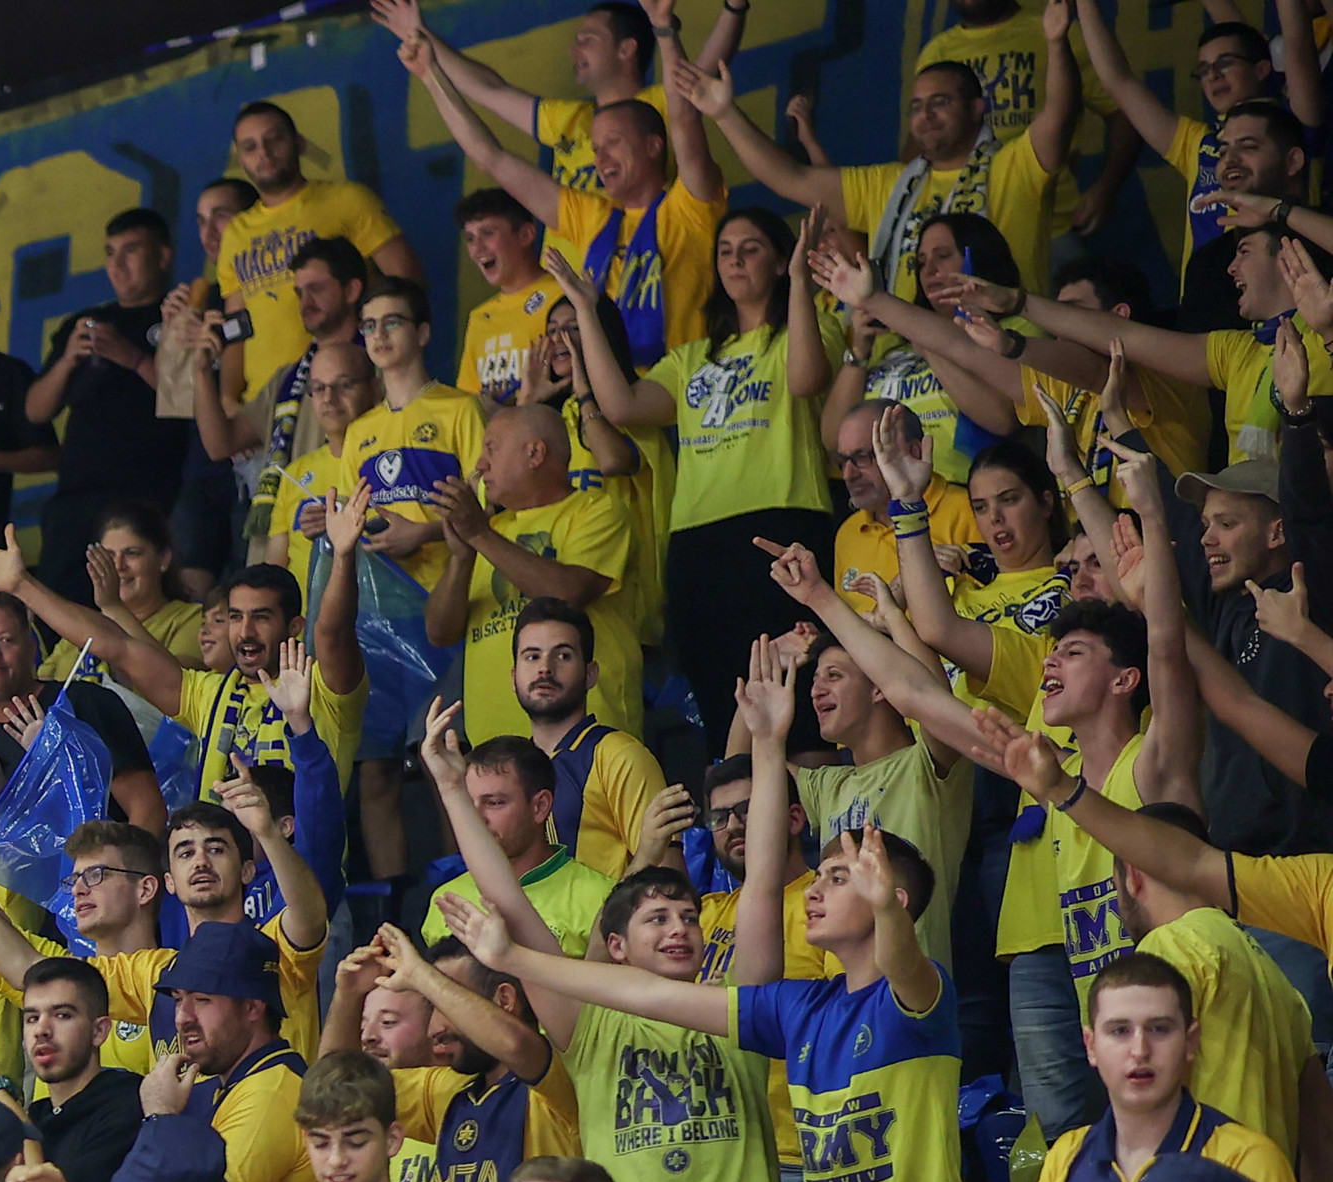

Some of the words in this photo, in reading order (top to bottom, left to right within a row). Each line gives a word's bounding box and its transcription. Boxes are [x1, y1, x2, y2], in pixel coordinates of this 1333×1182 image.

[615, 1124, 667, 1157] WHERE
[669, 1121, 677, 1147] I
[682, 1112, 742, 1147] BELONG
